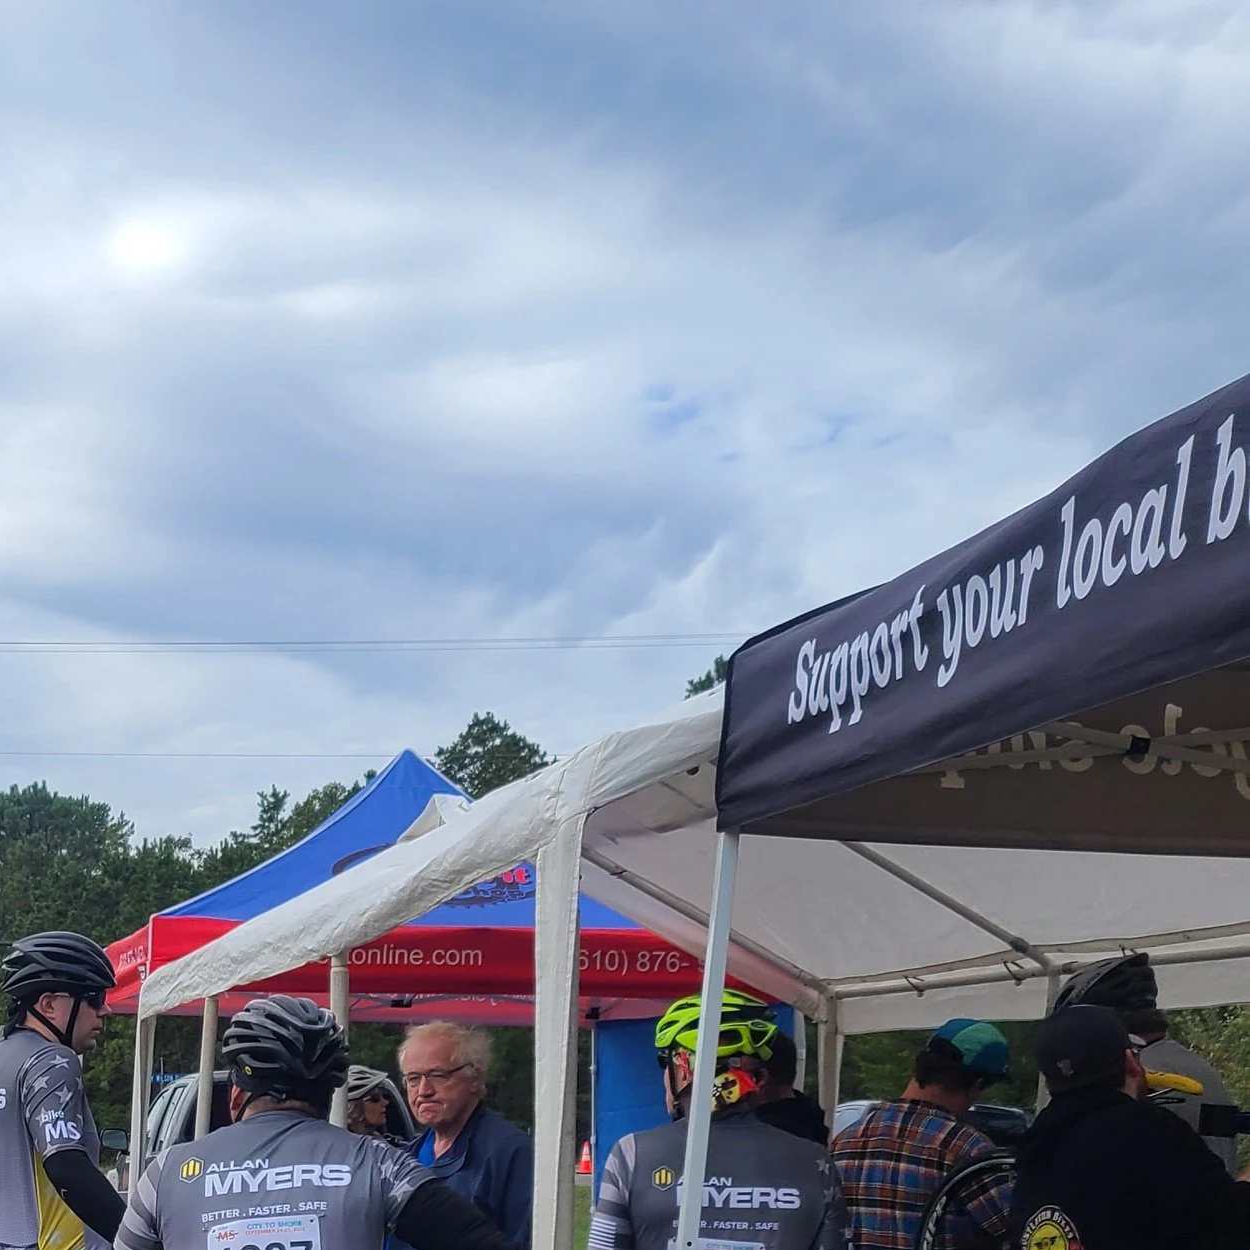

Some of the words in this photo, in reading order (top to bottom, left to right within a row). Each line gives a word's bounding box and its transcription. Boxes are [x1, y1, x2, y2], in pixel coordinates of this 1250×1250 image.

[787, 585, 930, 734] Support
[936, 544, 1044, 688] your
[1056, 434, 1196, 610] local
[1206, 413, 1250, 545] b
[636, 950, 690, 973] 876-
[44, 1120, 82, 1143] MS
[205, 1158, 270, 1174] ALLAN
[204, 1164, 352, 1198] MYERS
[201, 1208, 240, 1223] BETTER
[248, 1203, 291, 1217] FASTER
[298, 1201, 328, 1212] SAFE
[265, 1221, 276, 1229] TO
[713, 1220, 749, 1230] FASTER
[755, 1222, 780, 1231] SAFE
